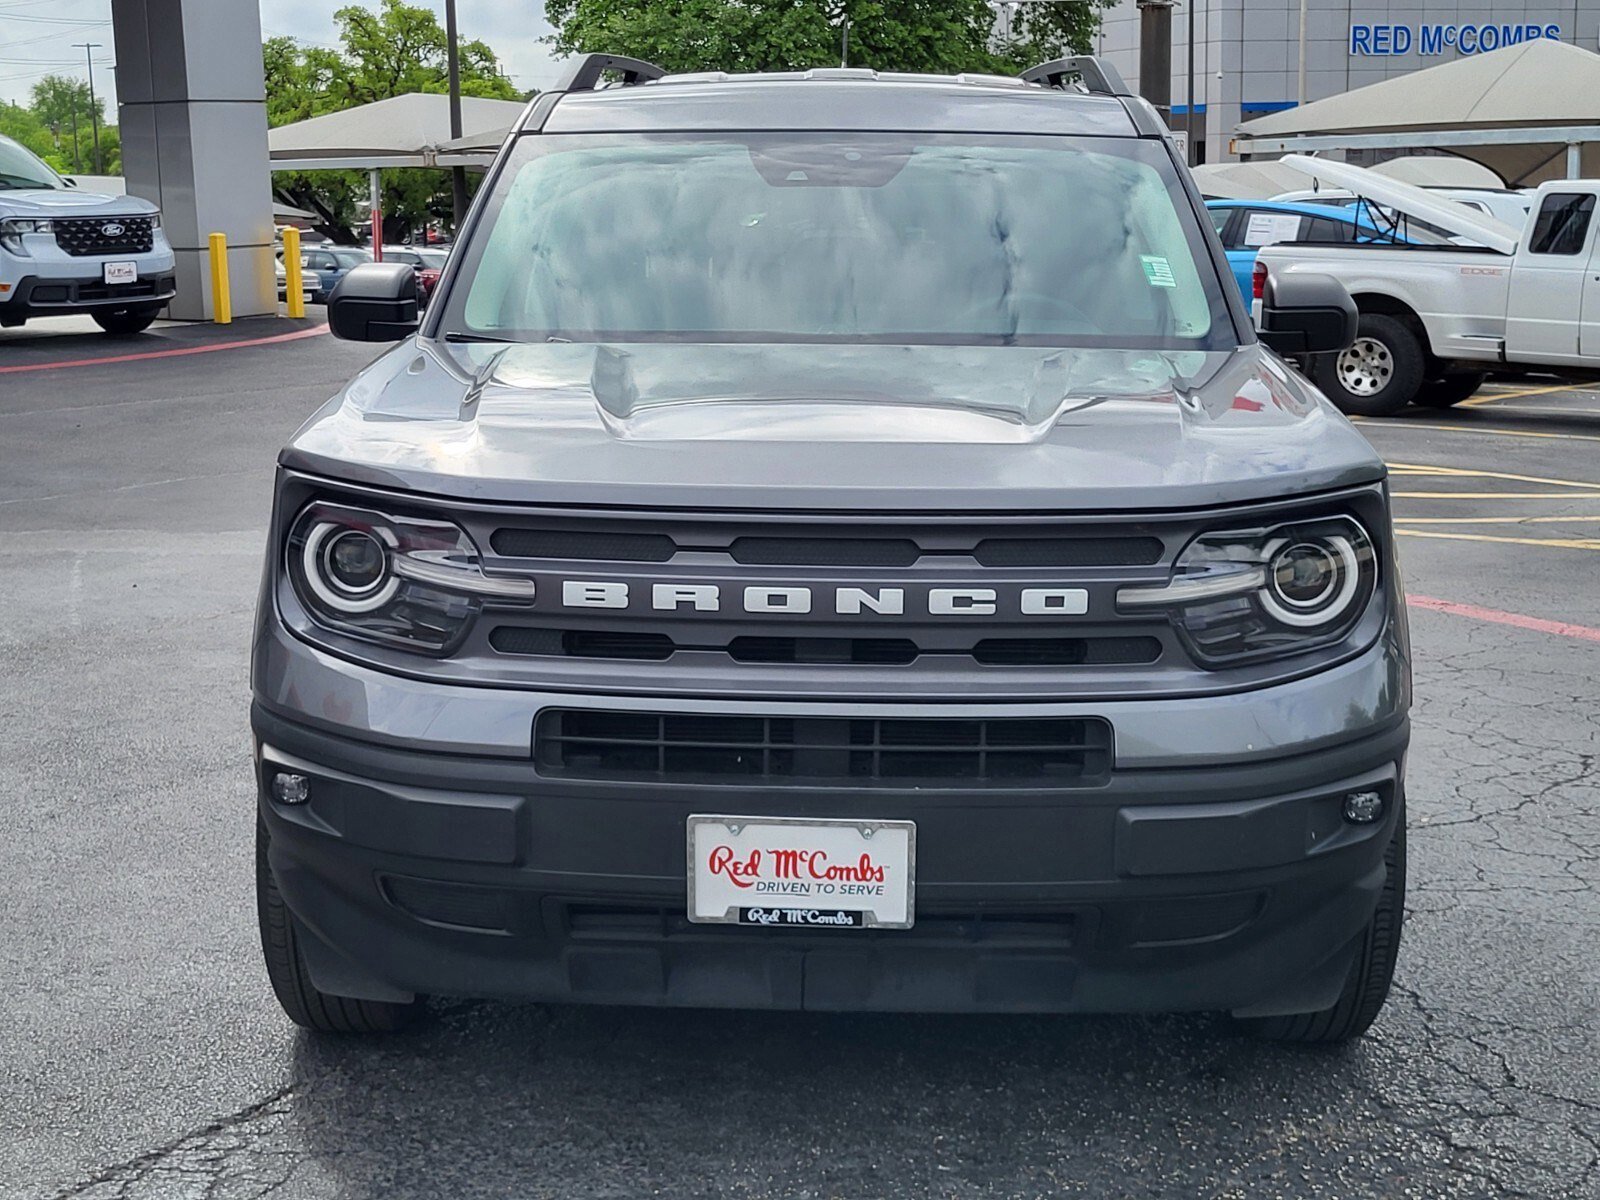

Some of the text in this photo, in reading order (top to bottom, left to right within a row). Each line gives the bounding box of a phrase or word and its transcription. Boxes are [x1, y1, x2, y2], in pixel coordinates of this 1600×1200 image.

[1350, 24, 1412, 55] RED
[562, 580, 1089, 616] BRONCO
[708, 845, 885, 889] Red McCombs
[755, 881, 885, 896] DRIVEN TO SERVE
[747, 908, 854, 926] Red McCombs
